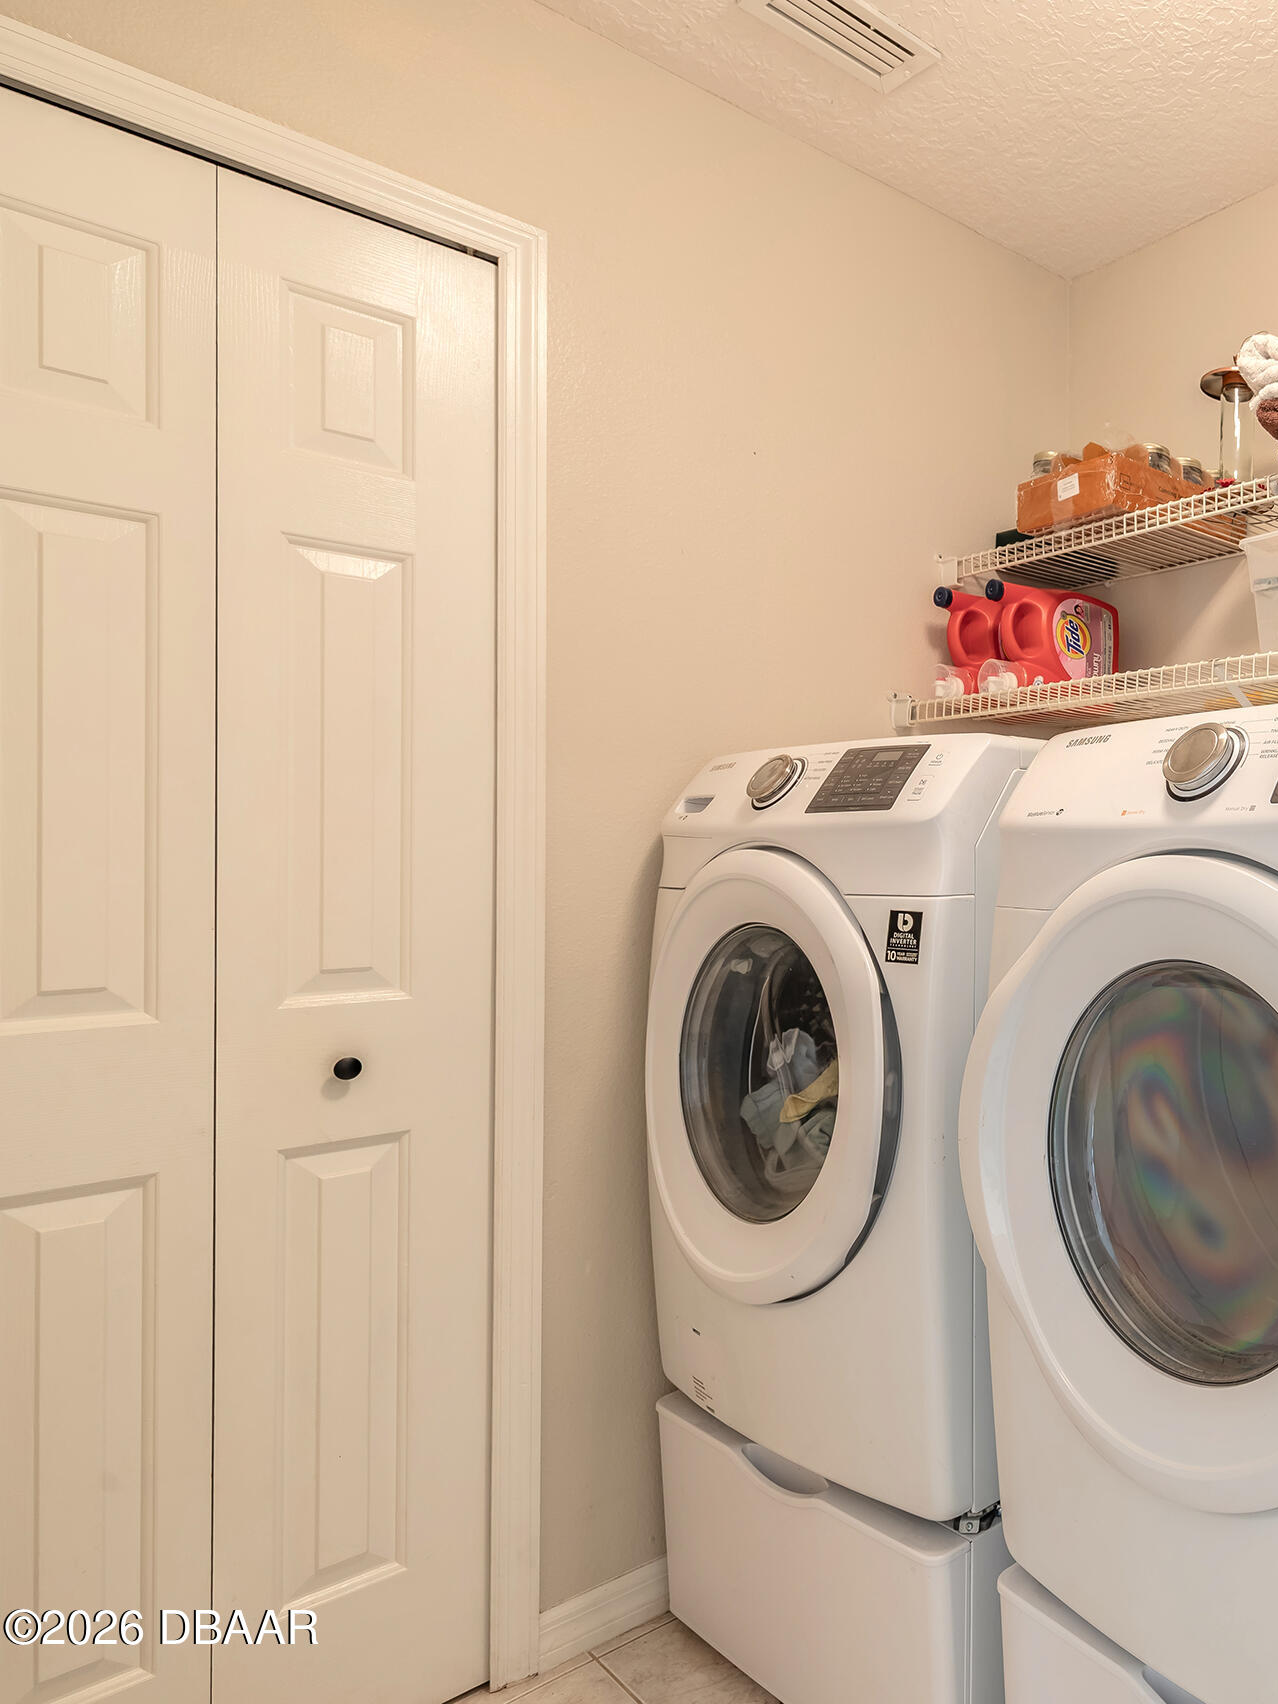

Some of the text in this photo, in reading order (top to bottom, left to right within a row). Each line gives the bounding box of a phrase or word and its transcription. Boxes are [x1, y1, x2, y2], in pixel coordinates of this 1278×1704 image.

[1064, 619, 1085, 656] Tide
[1092, 653, 1102, 678] owny
[1066, 734, 1111, 748] SAMSUNG
[887, 951, 897, 961] 10
